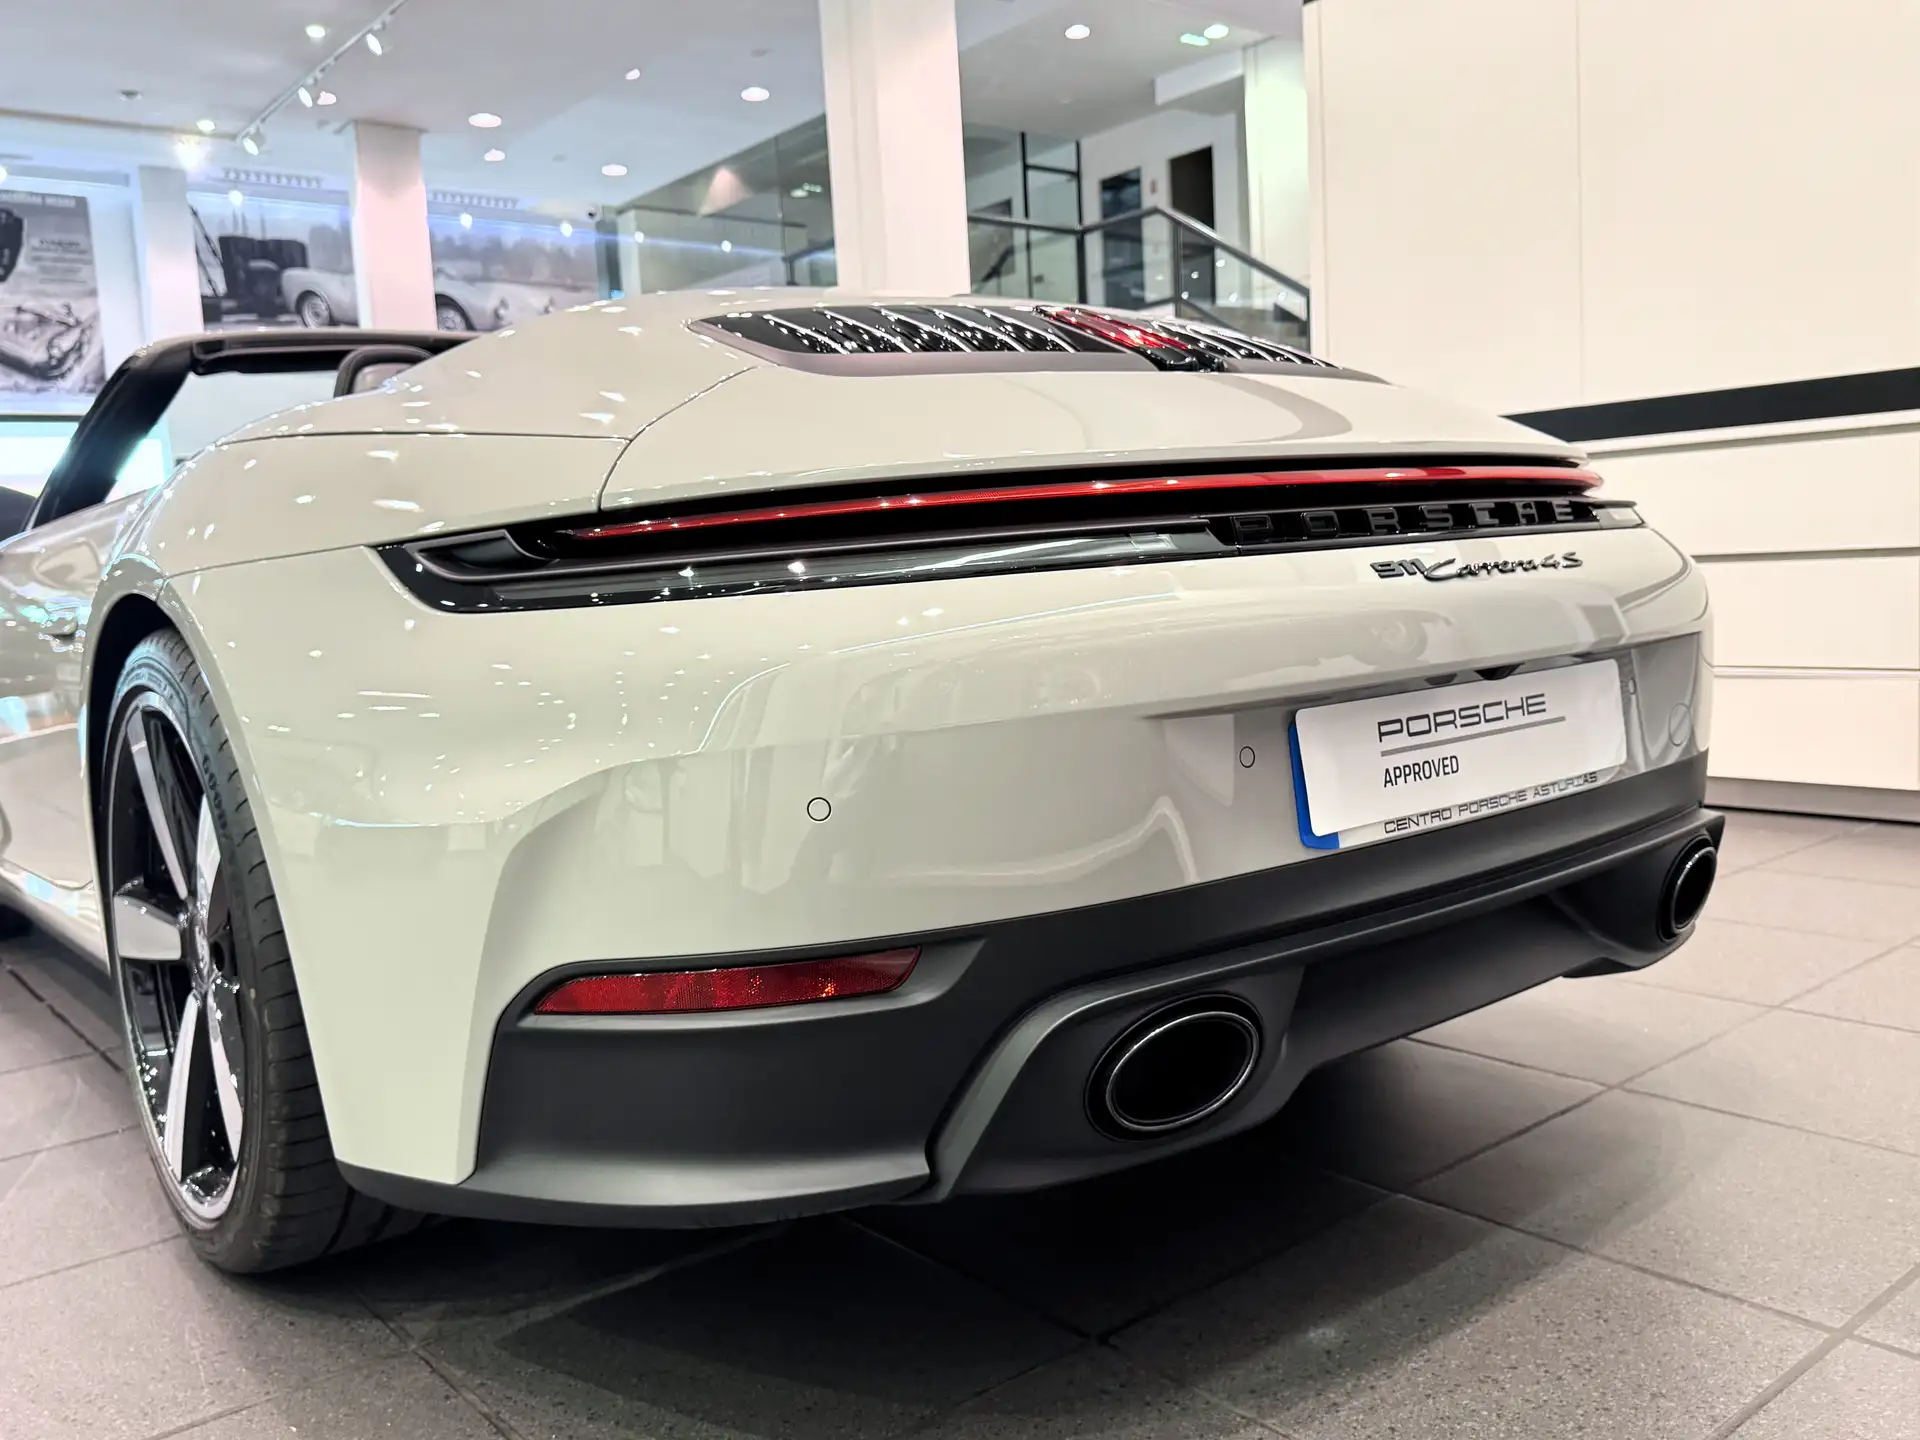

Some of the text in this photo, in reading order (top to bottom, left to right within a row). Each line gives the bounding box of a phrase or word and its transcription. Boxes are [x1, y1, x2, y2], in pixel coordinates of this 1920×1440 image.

[1230, 500, 1574, 546] PORSCHE
[1369, 557, 1426, 579] 911
[1423, 557, 1539, 581] Carrera
[1377, 693, 1547, 743] PORSCHE
[1383, 755, 1460, 788] APPROVED
[1384, 771, 1598, 834] CENTRO PORSCHE ASTURIAS
